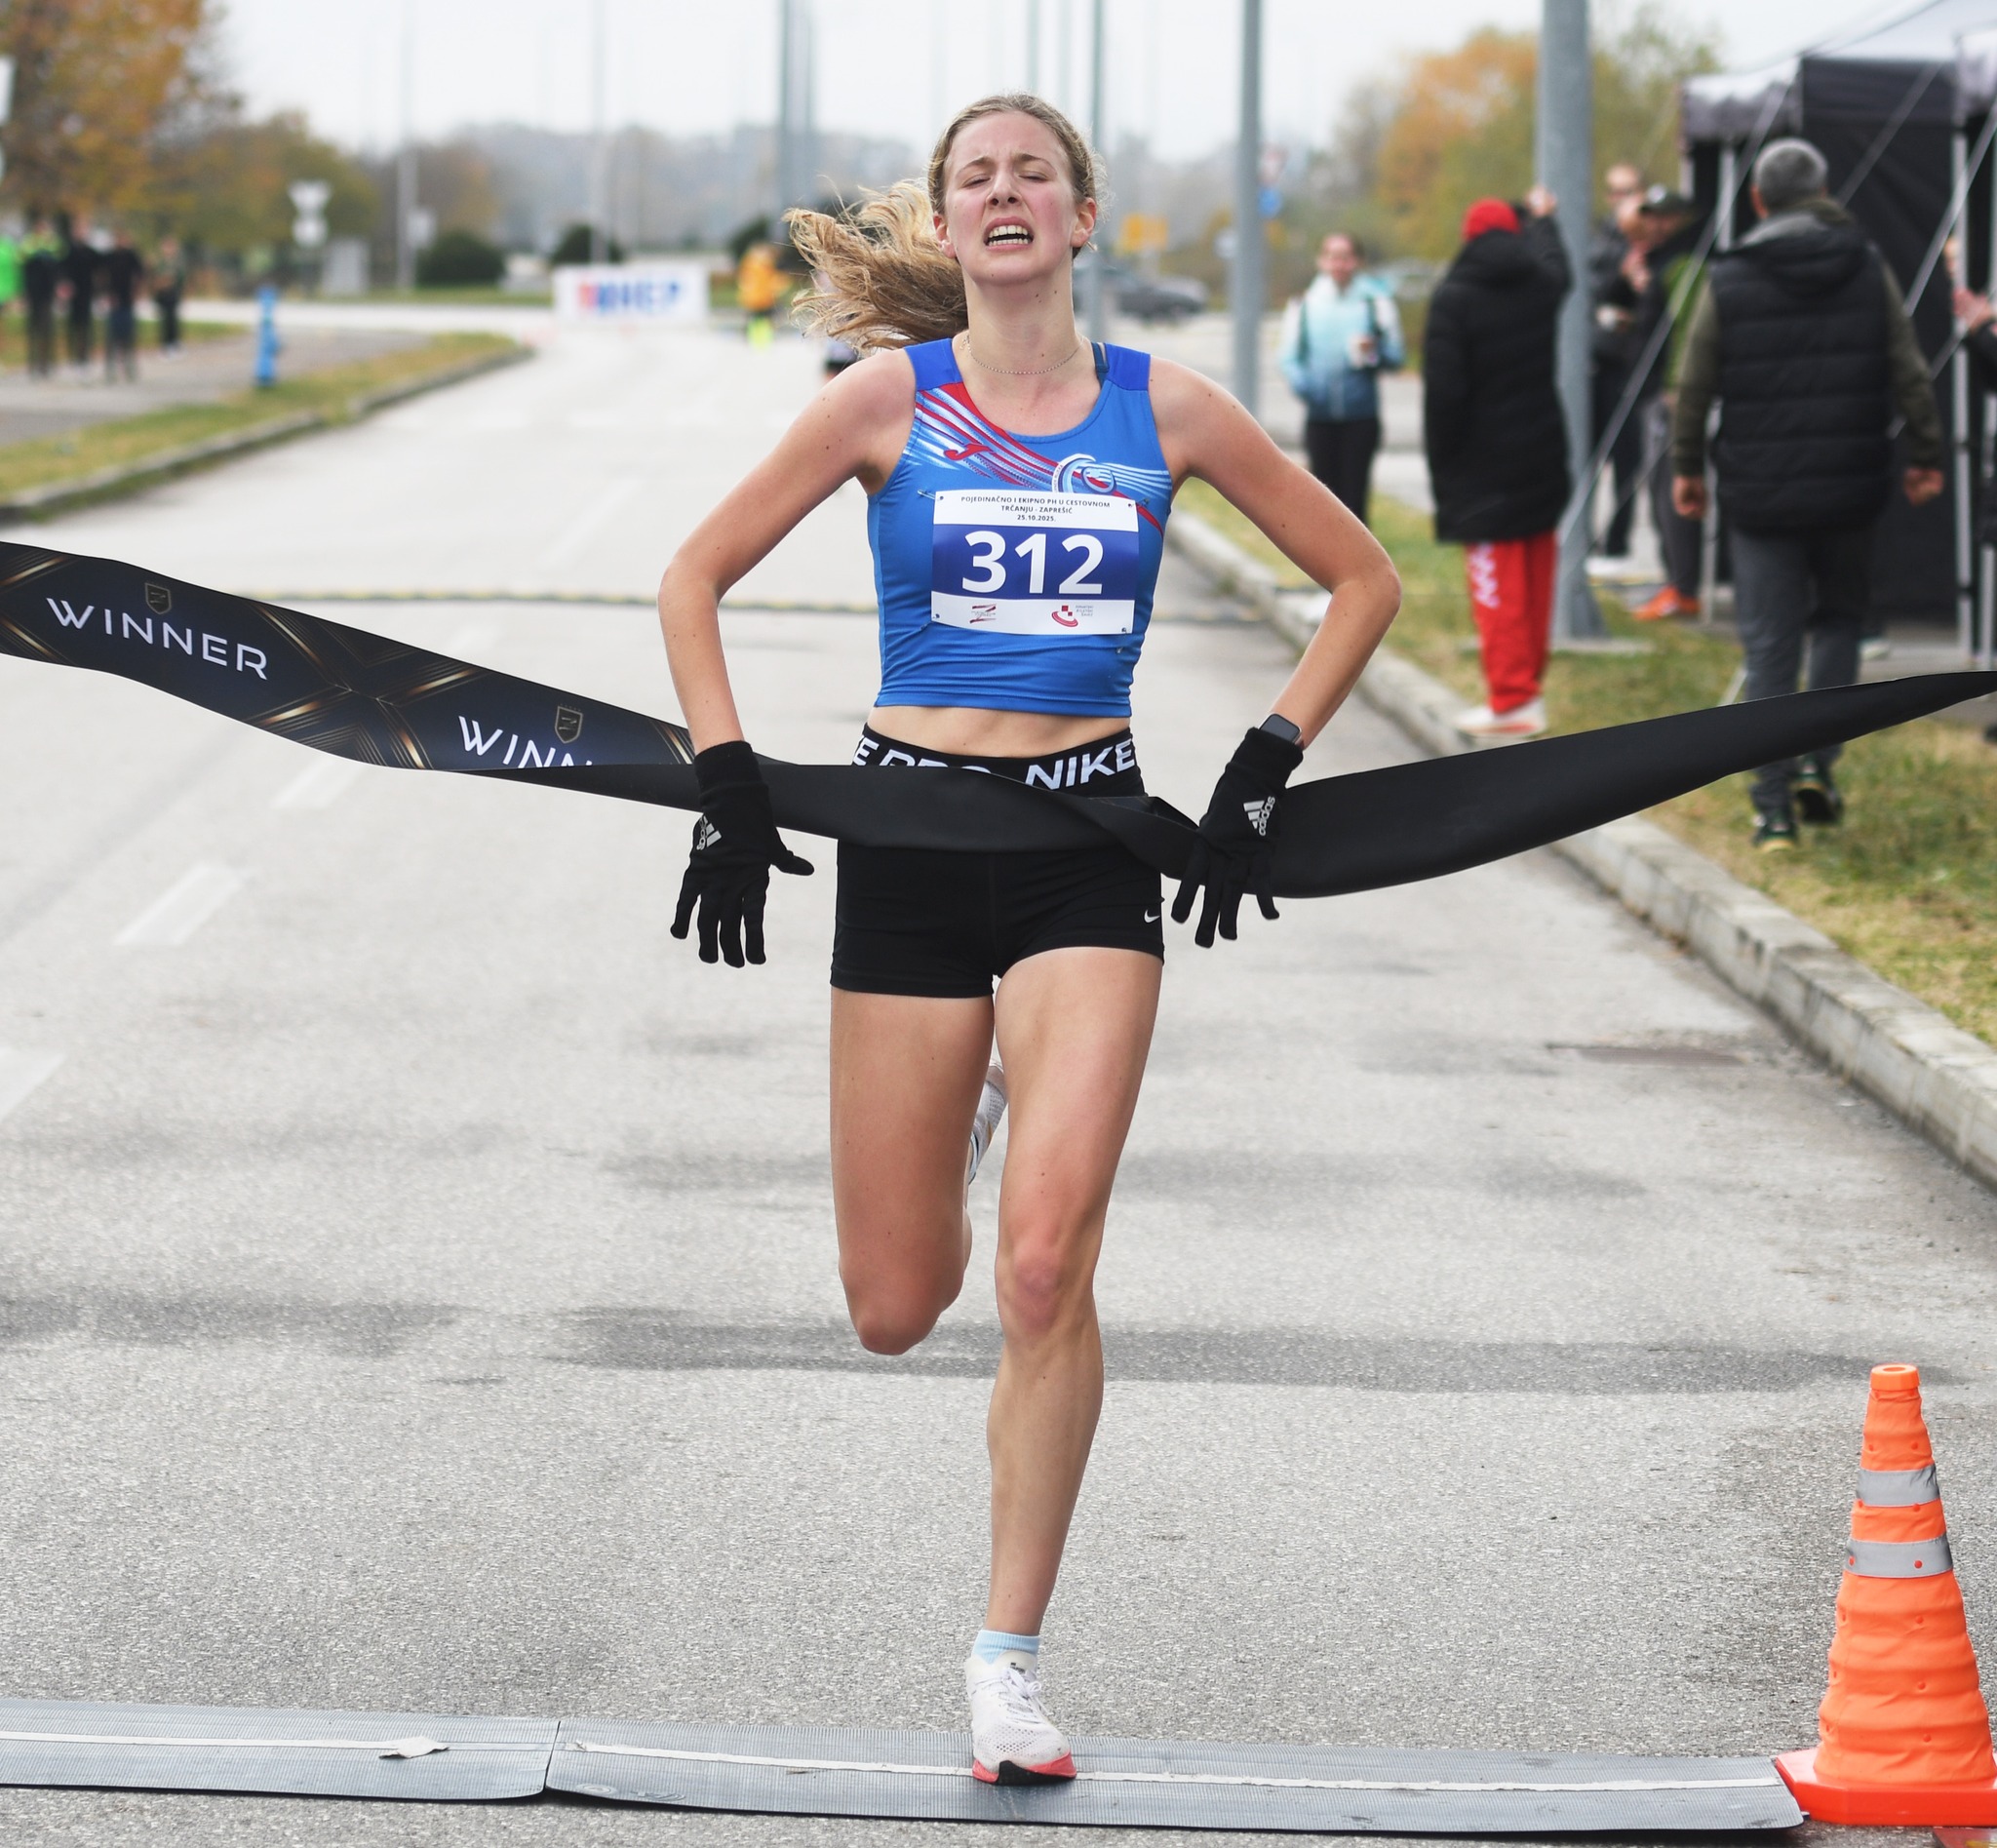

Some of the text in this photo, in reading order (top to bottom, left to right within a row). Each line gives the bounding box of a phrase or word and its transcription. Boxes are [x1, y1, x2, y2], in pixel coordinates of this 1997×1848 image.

[1001, 504, 1034, 513] TRČANJU
[1039, 505, 1073, 514] ZAPREŠIĆ
[1066, 499, 1111, 508] CESTOVNOM
[962, 531, 1104, 594] 312
[46, 597, 268, 681] WINNER
[1025, 738, 1136, 791] NIKE
[1258, 795, 1275, 837] adidas
